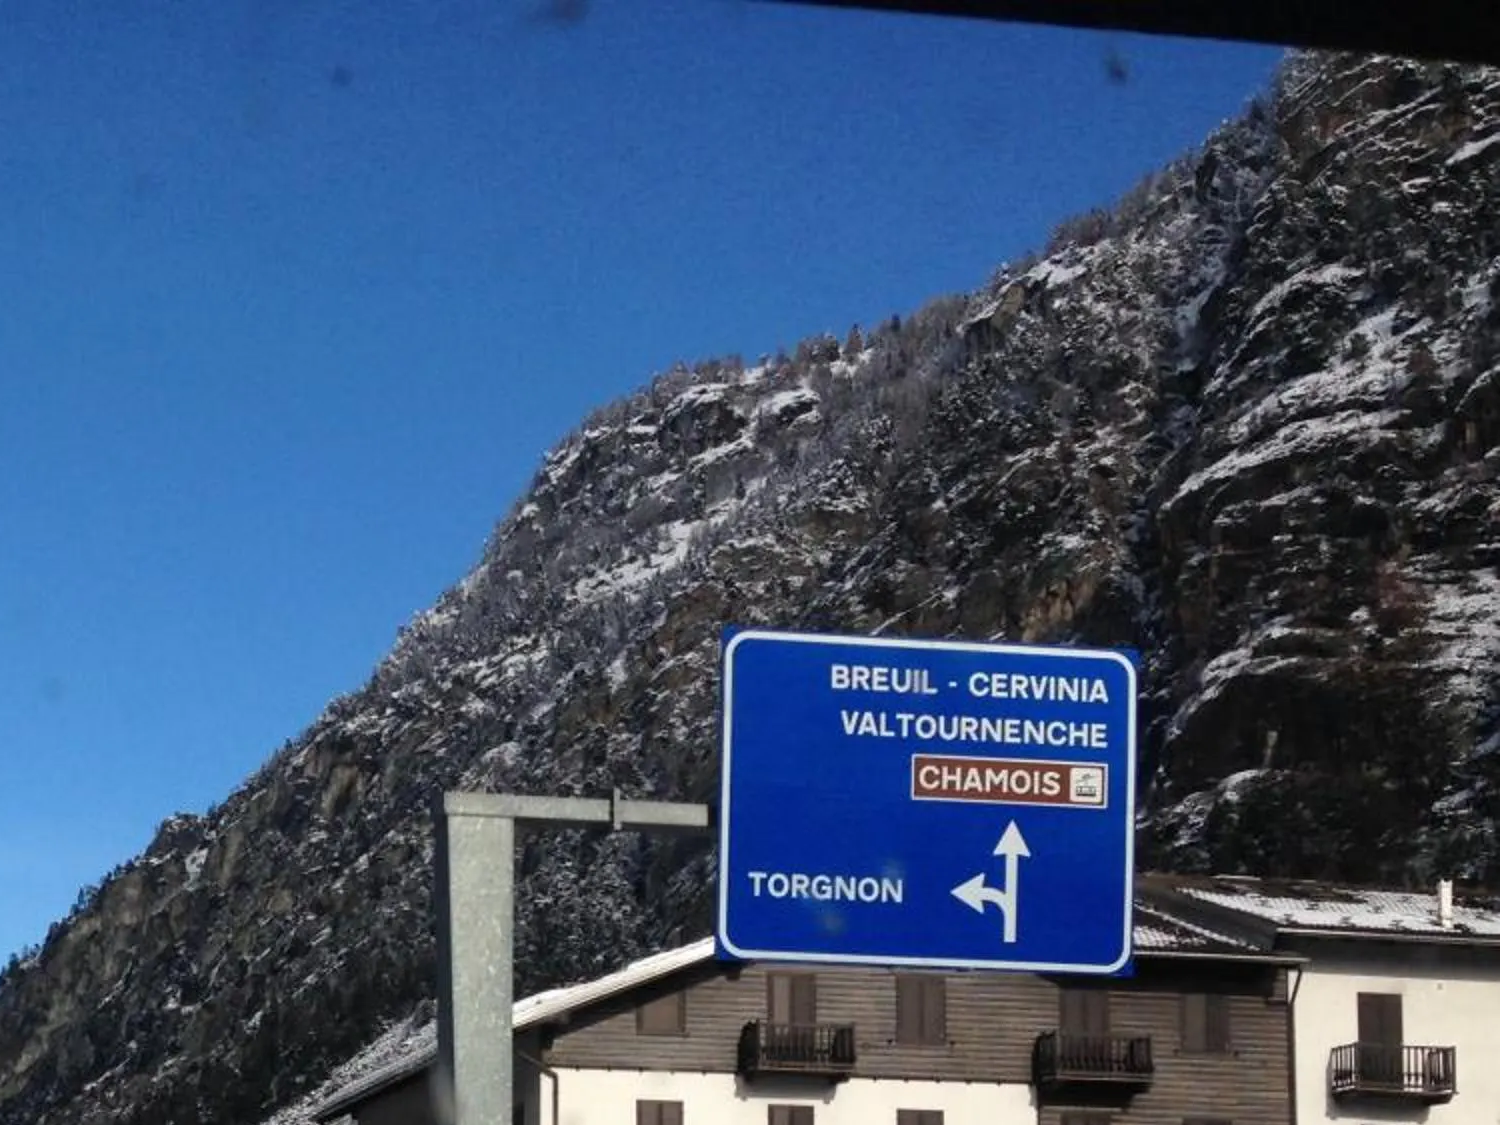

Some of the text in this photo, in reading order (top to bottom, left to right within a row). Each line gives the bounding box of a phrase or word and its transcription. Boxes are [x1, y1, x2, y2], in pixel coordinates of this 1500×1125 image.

[831, 664, 938, 695] BREUIL
[969, 672, 1109, 703] CERVINIA
[841, 710, 1108, 748] VALTOURNENCHE
[918, 765, 1061, 797] CHAMOIS
[748, 872, 903, 902] TORGNON
